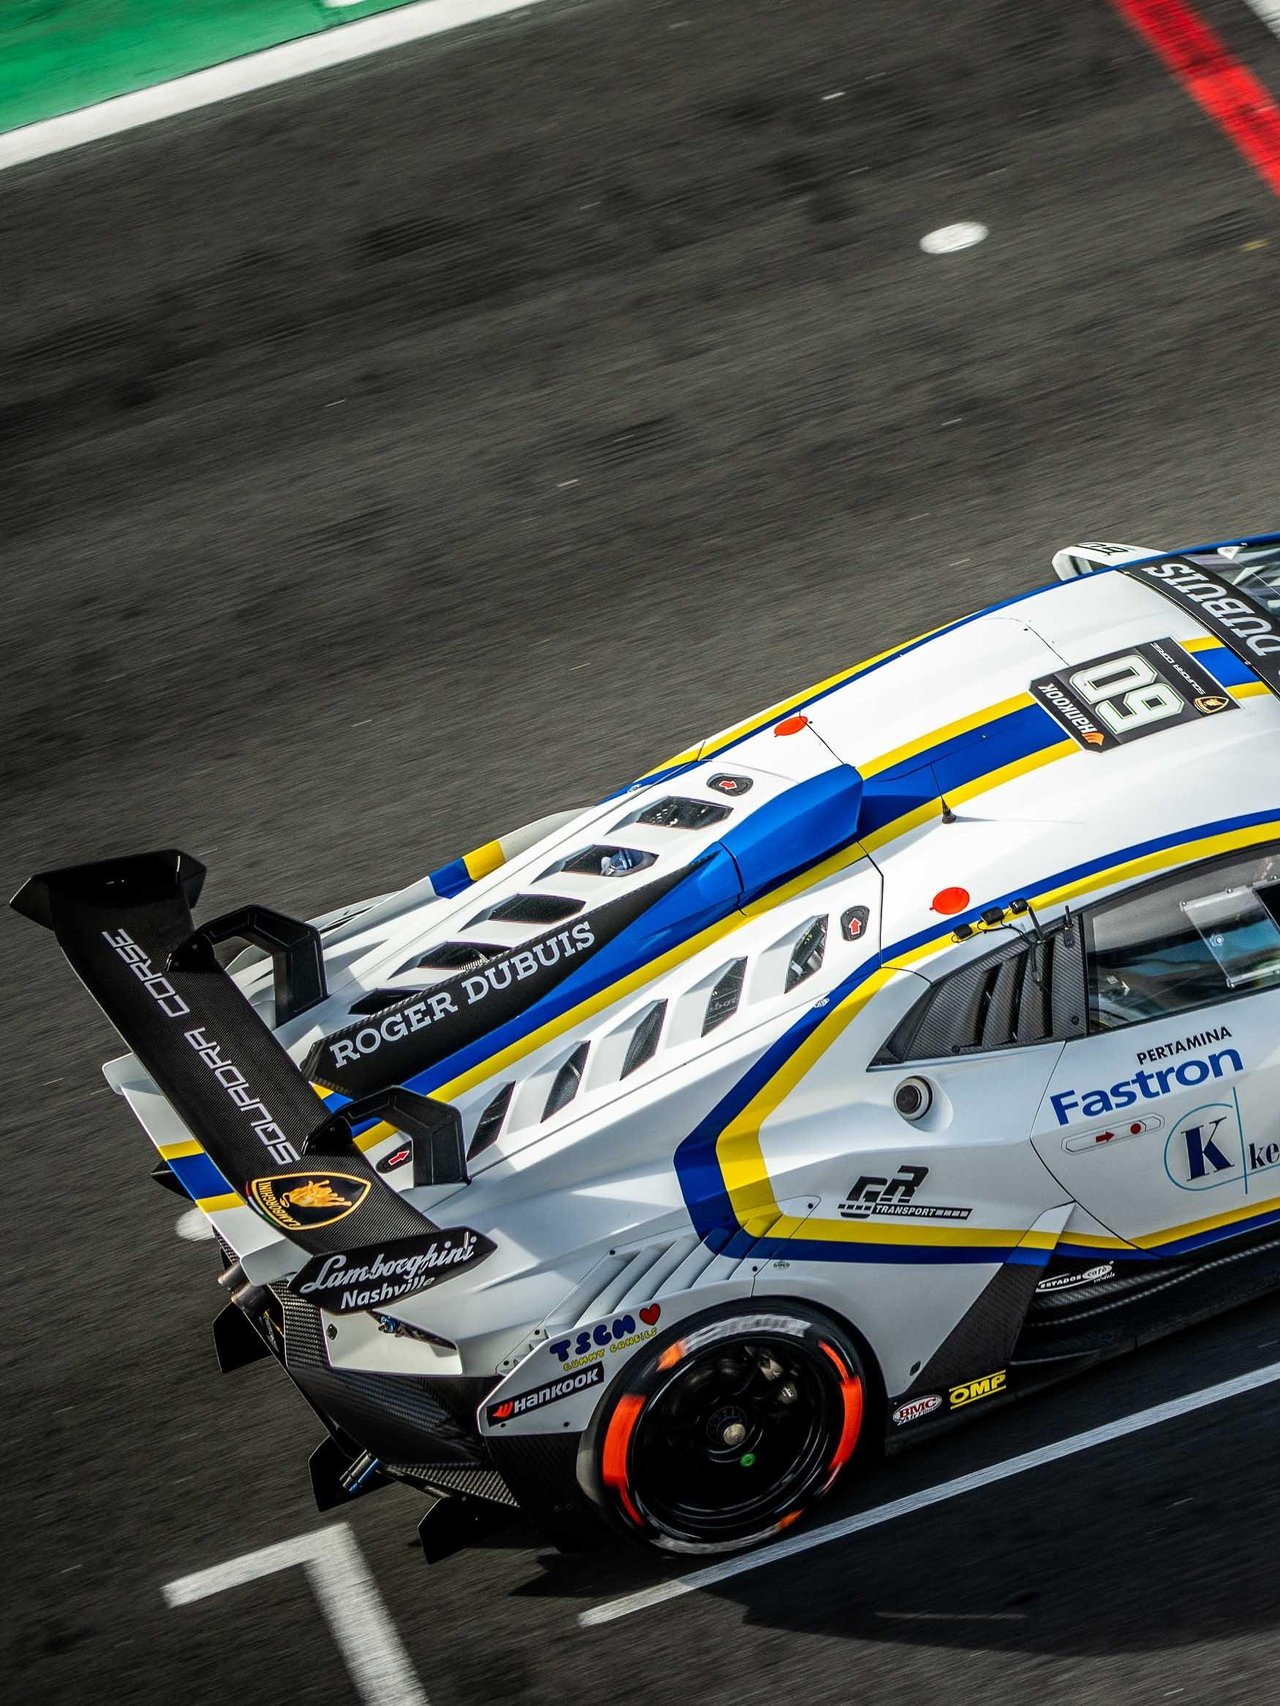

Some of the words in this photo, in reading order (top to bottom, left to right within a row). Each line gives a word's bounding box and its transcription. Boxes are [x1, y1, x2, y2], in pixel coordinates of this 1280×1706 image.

[1069, 654, 1185, 735] 60
[1173, 663, 1207, 696] SQUADRA
[102, 928, 190, 1017] CORSE
[329, 991, 459, 1068] ROGER
[461, 922, 596, 1004] DUBUIS
[1136, 1026, 1232, 1065] PERTAMINA
[184, 1027, 300, 1166] SQUADRA
[1050, 1048, 1244, 1126] Fastron
[1180, 1116, 1235, 1182] K
[257, 1181, 302, 1228] LAMBORGHINI
[875, 1204, 936, 1217] TRANSPORT
[300, 1235, 478, 1294] Lamborghini
[1039, 1274, 1082, 1290] ESTADOS
[340, 1275, 436, 1310] Nashville
[899, 1398, 938, 1419] BMC
[950, 1373, 1007, 1405] OMP
